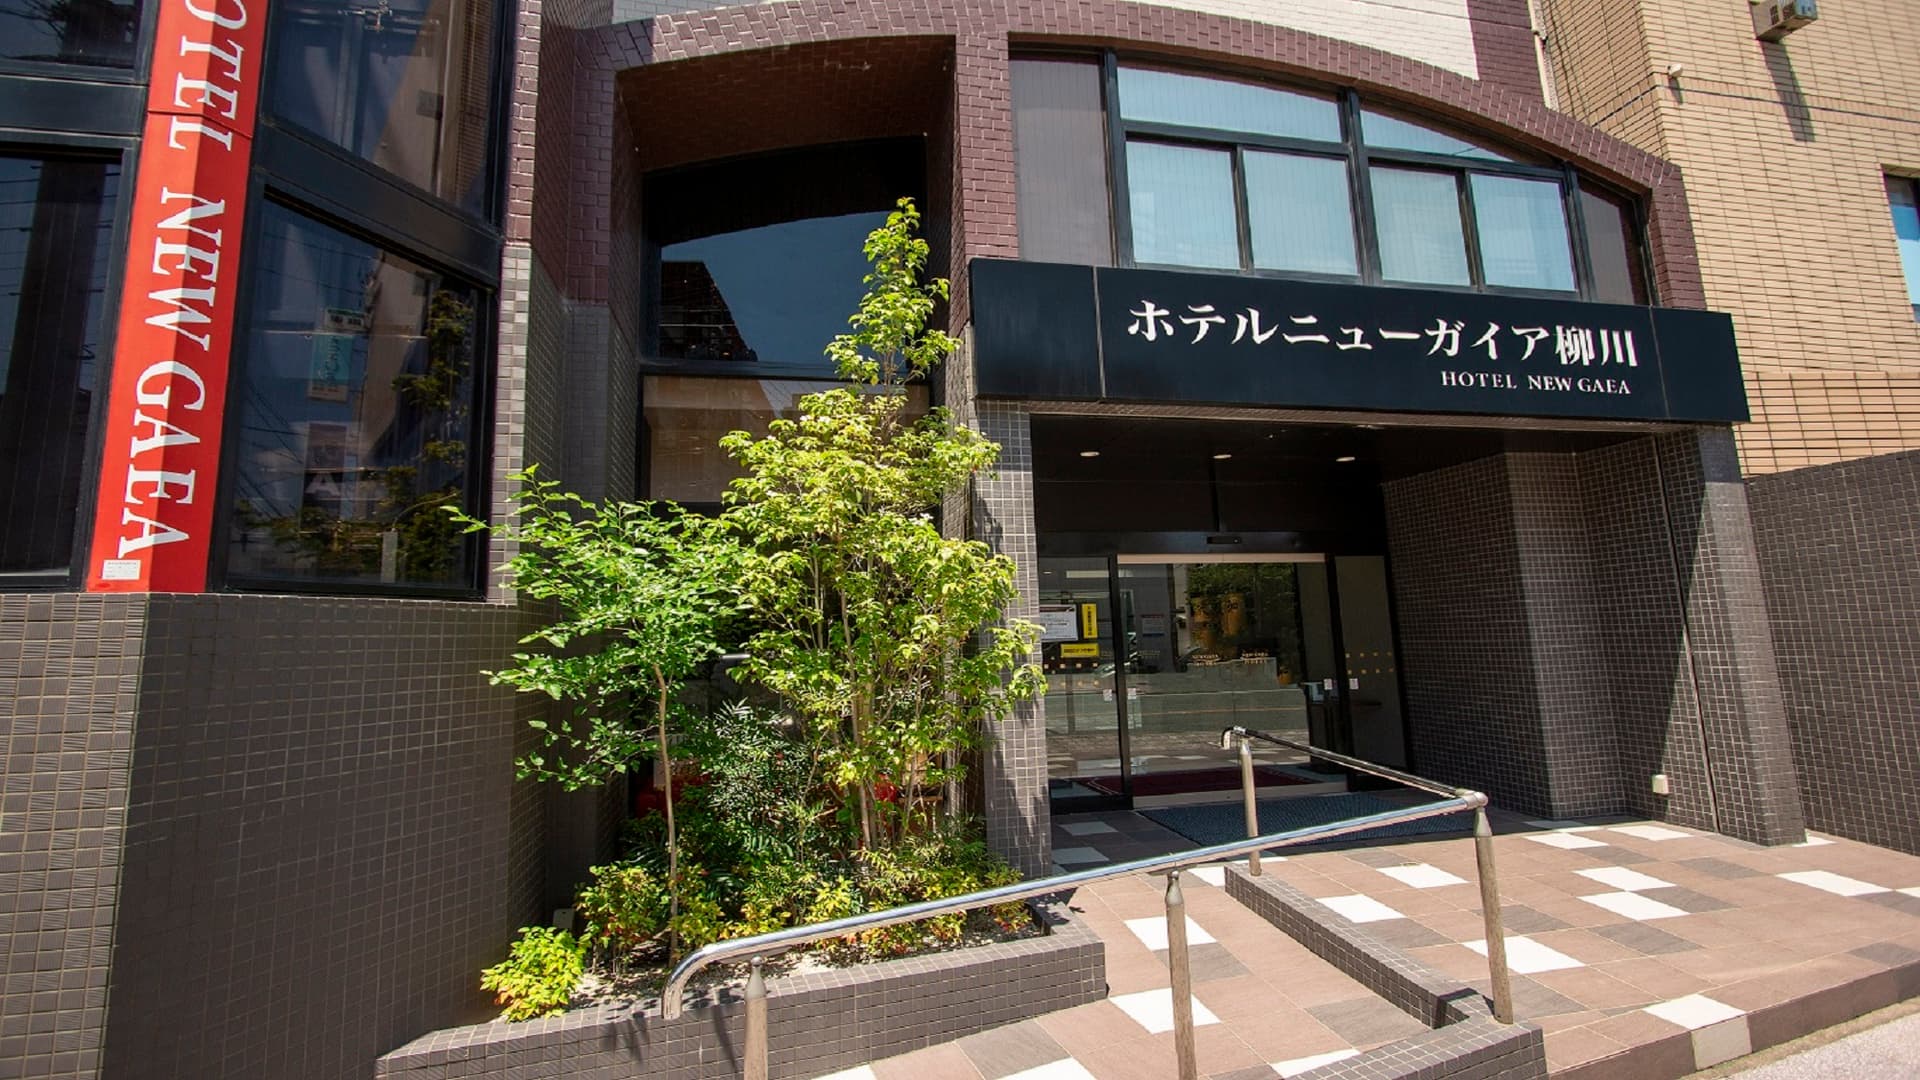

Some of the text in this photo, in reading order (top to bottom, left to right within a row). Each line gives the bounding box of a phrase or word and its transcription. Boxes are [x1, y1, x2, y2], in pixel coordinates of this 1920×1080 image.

[144, 186, 226, 352] NEW
[1127, 299, 1638, 368] ホテルニューガイア柳川
[1440, 370, 1632, 395] HOTEL NEW GAEA
[117, 360, 206, 559] GAEA
